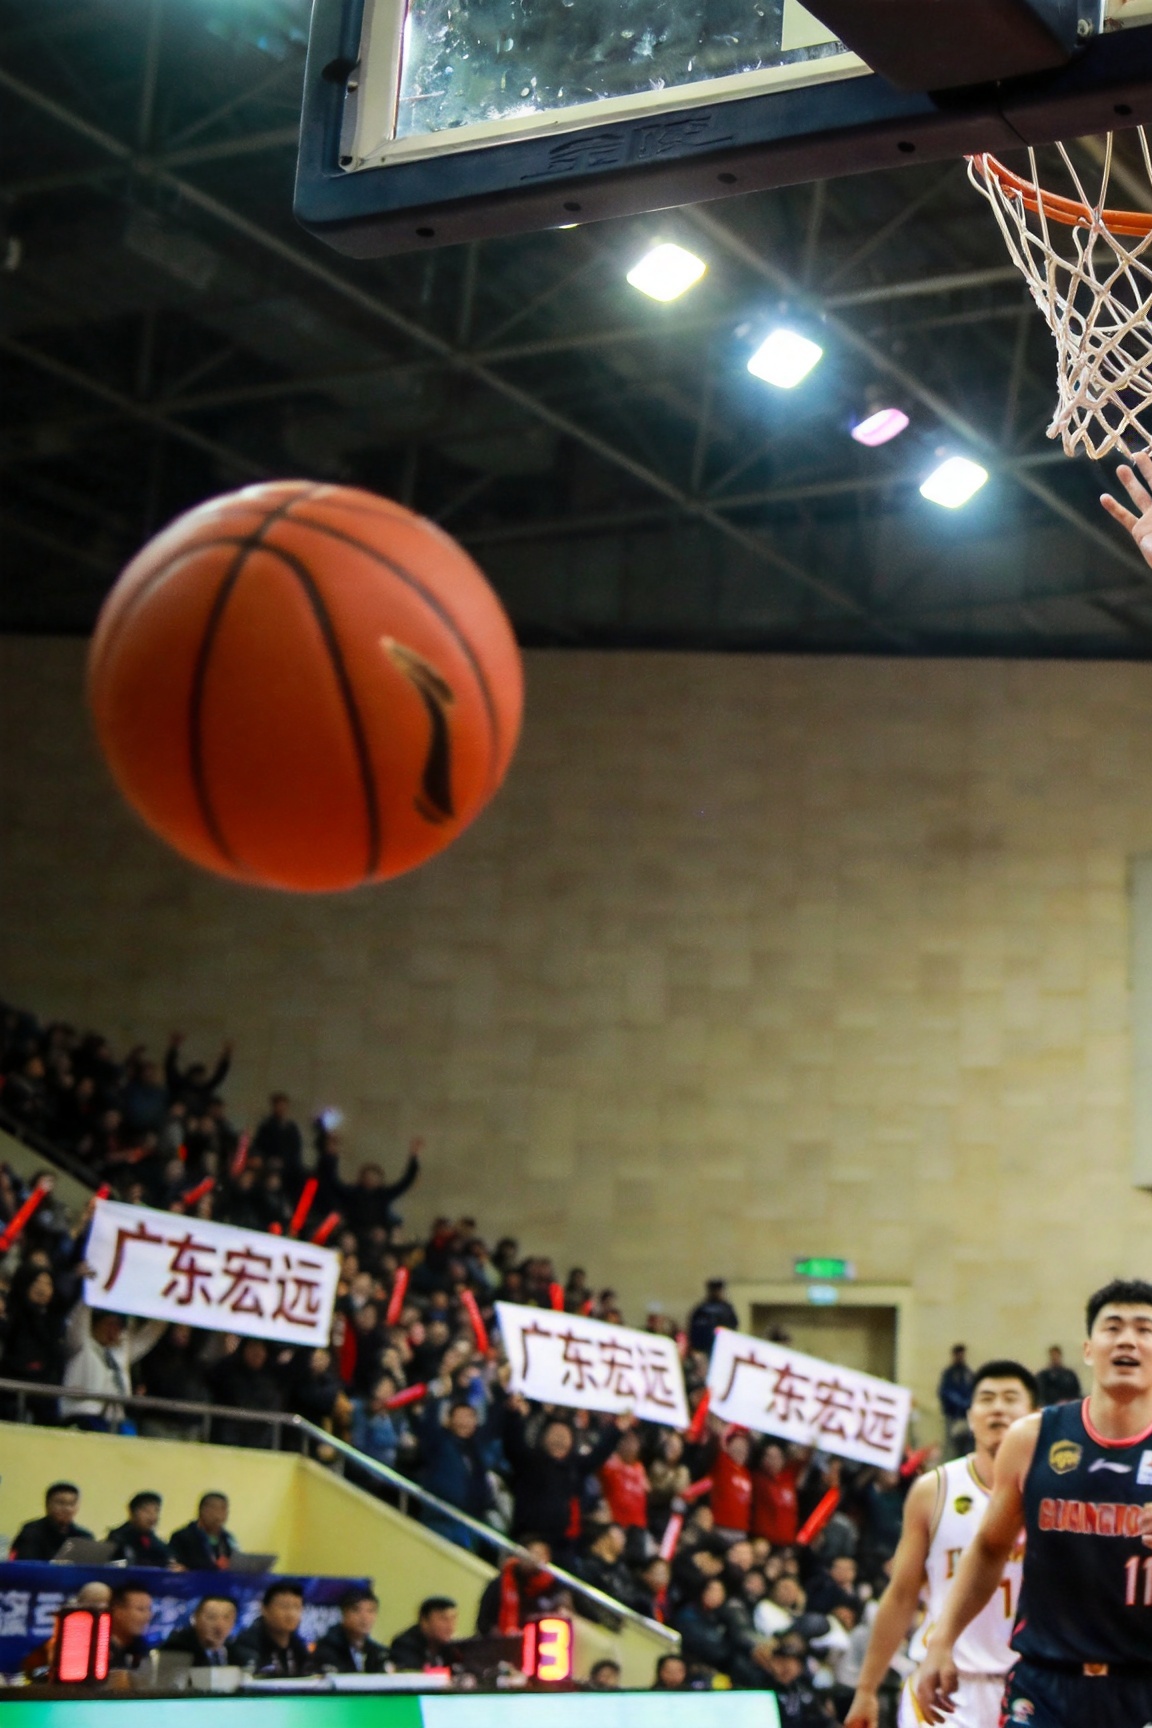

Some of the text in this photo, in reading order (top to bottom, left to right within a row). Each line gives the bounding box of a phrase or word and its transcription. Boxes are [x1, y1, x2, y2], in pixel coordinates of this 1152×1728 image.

[103, 1220, 324, 1328] 广东宏远
[520, 1320, 678, 1410] 广东宏远
[720, 1350, 900, 1453] 广东宏远
